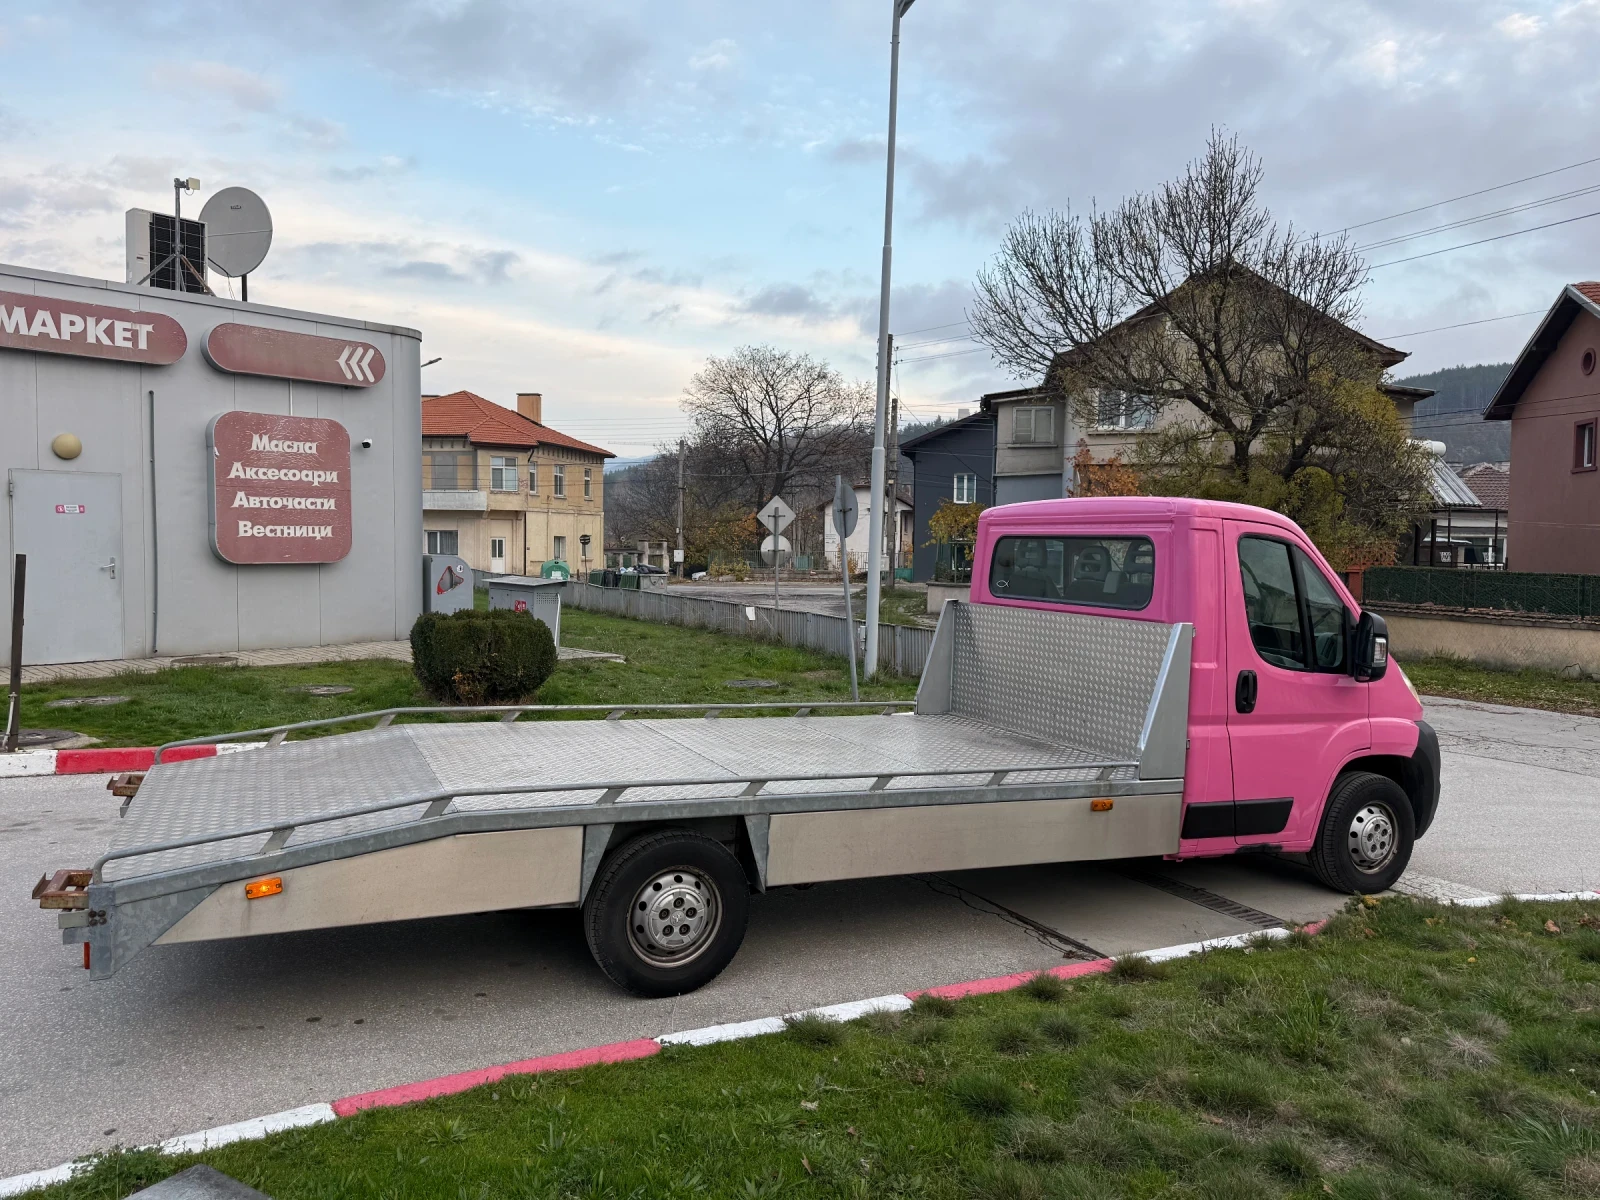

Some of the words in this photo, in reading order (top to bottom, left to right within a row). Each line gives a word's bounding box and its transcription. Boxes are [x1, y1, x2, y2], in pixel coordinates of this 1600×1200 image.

[0, 304, 154, 350] МАРКЕТ
[251, 433, 317, 454] Масла
[227, 462, 338, 486] Аксесоари
[231, 491, 337, 510] Авточасти
[237, 520, 333, 540] Вестници
